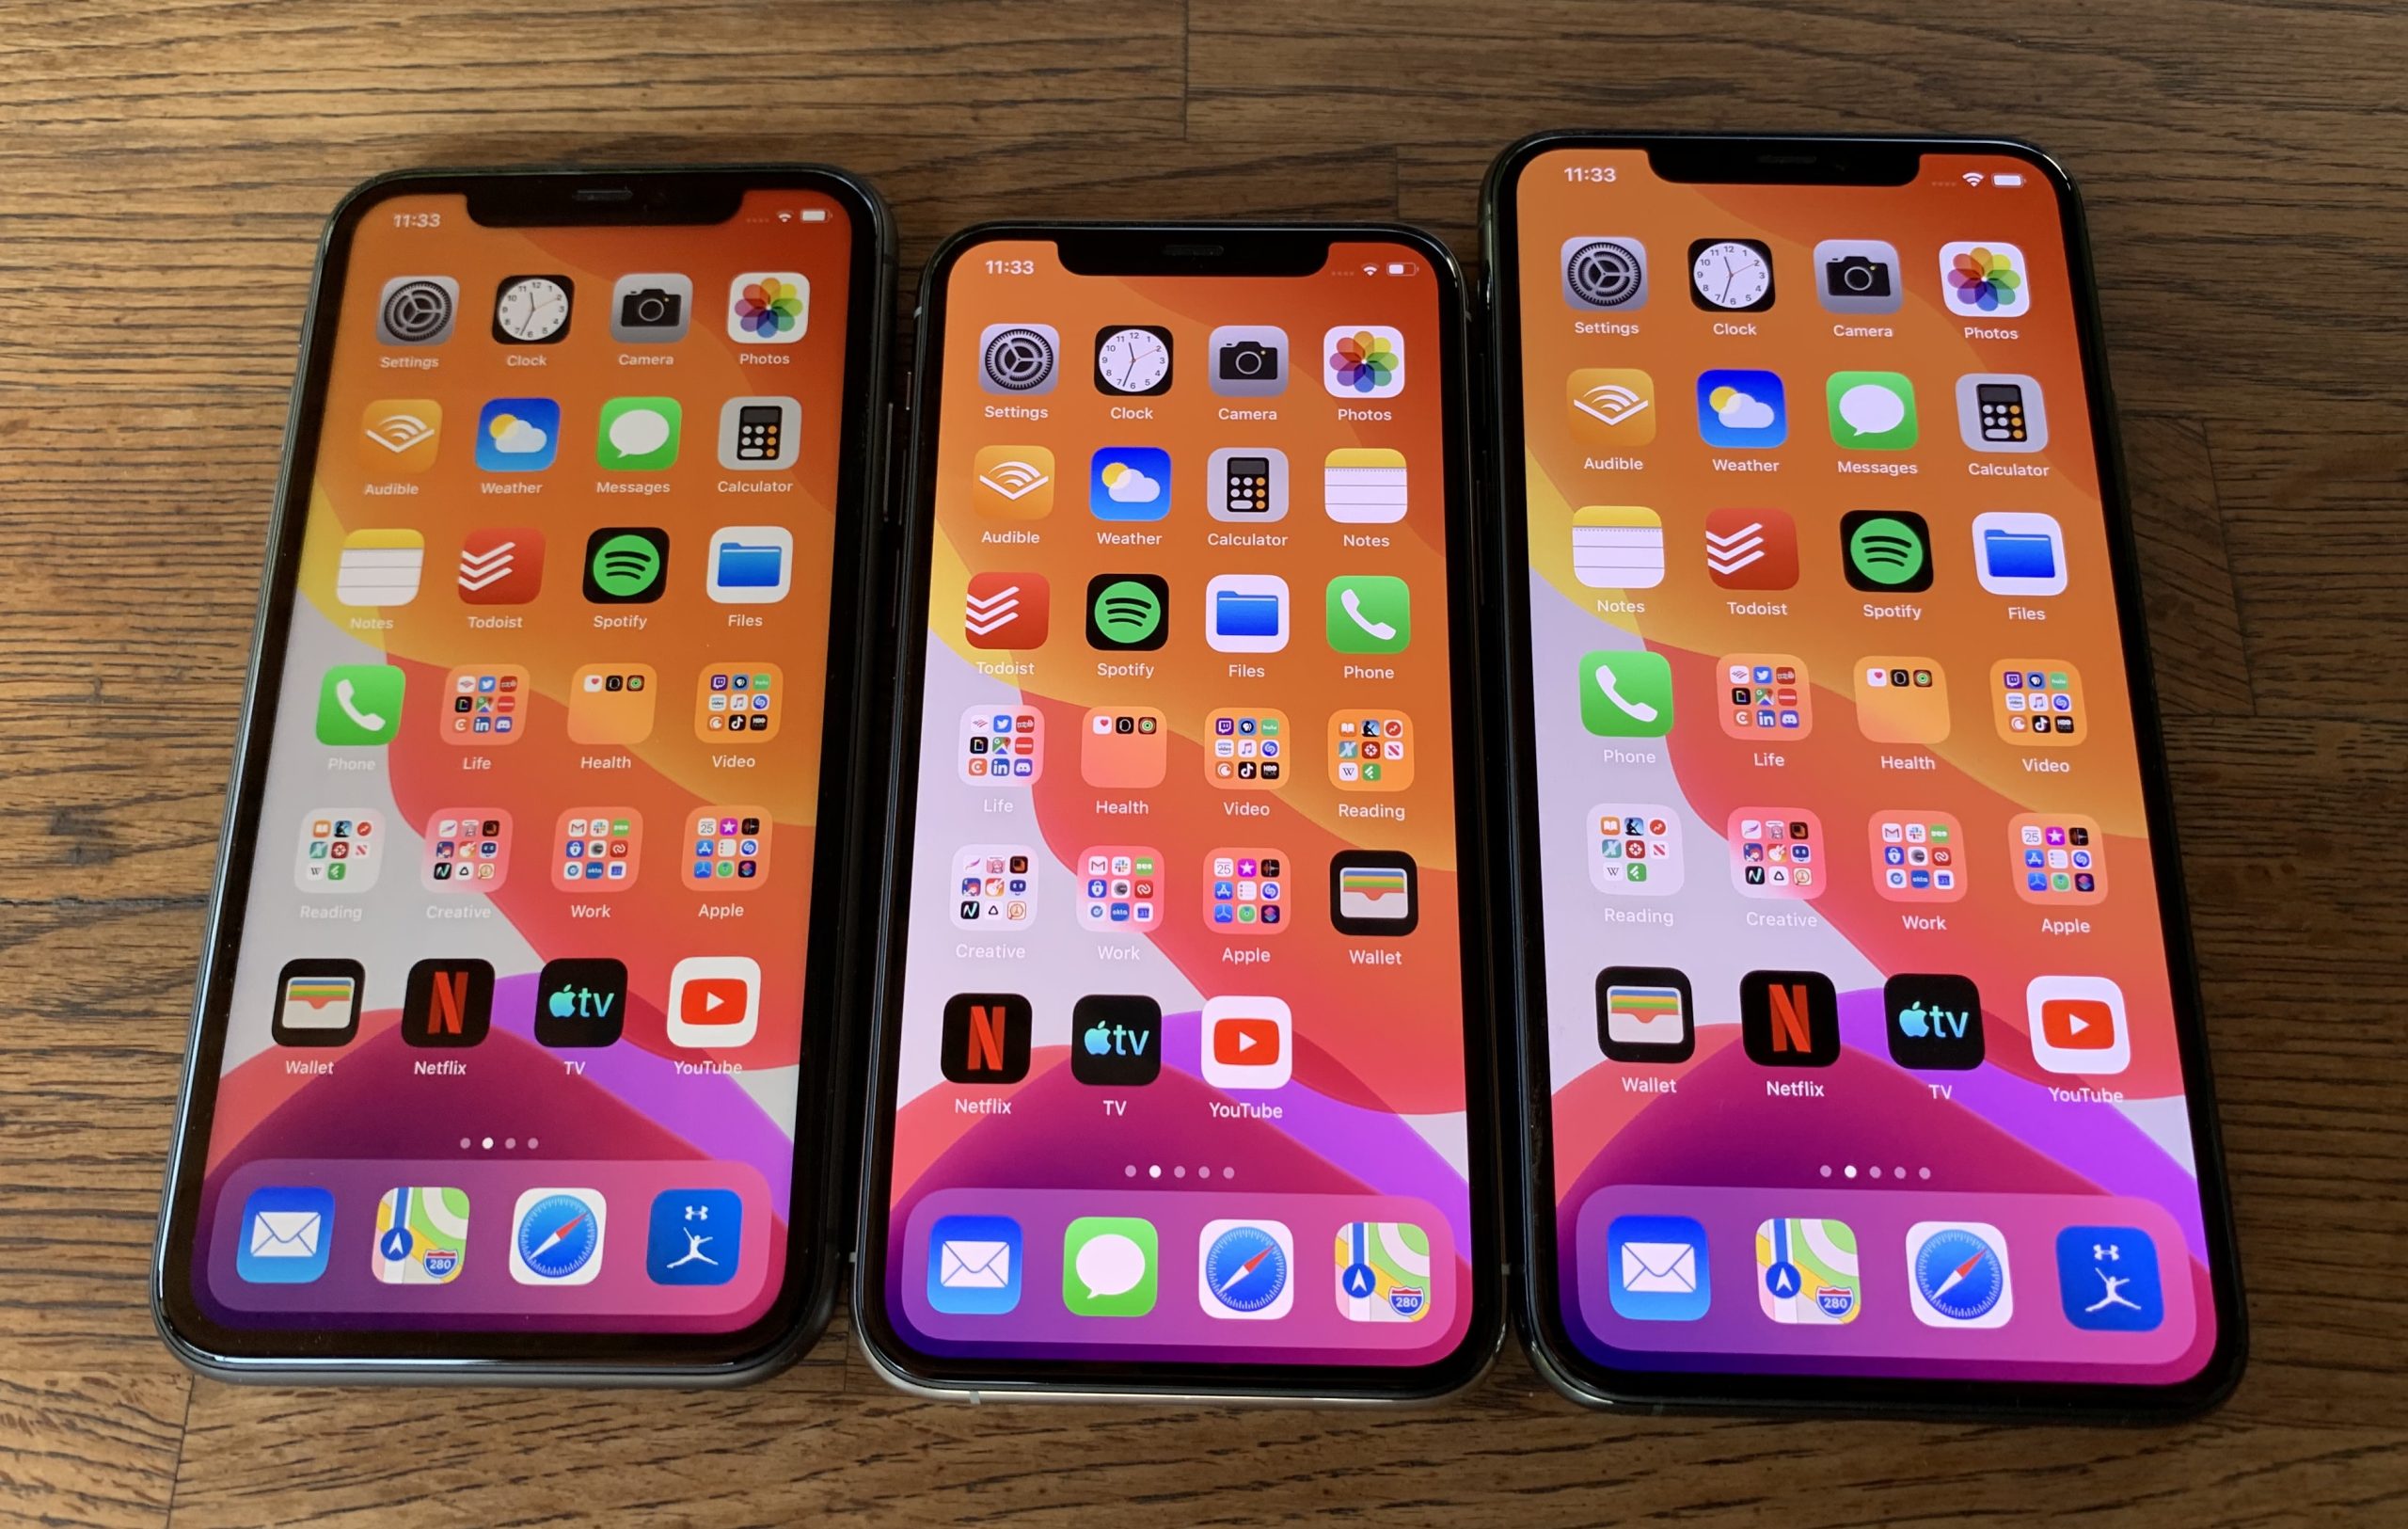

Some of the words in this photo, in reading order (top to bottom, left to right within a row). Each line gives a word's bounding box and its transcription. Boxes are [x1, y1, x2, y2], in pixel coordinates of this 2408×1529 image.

[1563, 167, 1617, 183] 11:33
[393, 213, 441, 228] 11:33
[985, 260, 1035, 275] 11:33
[1575, 321, 1640, 337] Settings
[1712, 323, 1757, 336] Clock
[1832, 324, 1894, 338] Camera
[1963, 327, 2020, 340] Photos
[379, 356, 439, 371] Settings
[505, 354, 547, 367] Clock
[617, 353, 674, 366] Camera
[739, 353, 790, 365] Photos
[984, 405, 1049, 422] Settings
[1110, 406, 1153, 420] Clock
[1218, 407, 1277, 421] Camera
[1338, 408, 1392, 422] Photos
[1583, 456, 1644, 470] Audible
[1712, 458, 1780, 472] Weather
[1837, 460, 1919, 477] Messages
[1968, 462, 2051, 477] Calculator
[364, 483, 420, 496] Audible
[481, 482, 543, 494] Weather
[595, 481, 671, 496] Messages
[717, 480, 794, 493] Calculator
[981, 531, 1040, 544] Audible
[1097, 532, 1163, 546] Weather
[1207, 533, 1289, 547] Calculator
[1343, 534, 1390, 548] Notes
[1596, 599, 1646, 613] Notes
[1726, 601, 1788, 616] Todoist
[1862, 603, 1922, 621] Spotify
[2007, 606, 2047, 621] Files
[349, 617, 394, 629] Notes
[467, 615, 523, 629] Todoist
[593, 614, 648, 630] Spotify
[728, 613, 763, 627] Files
[977, 661, 1036, 676] Todoist
[1097, 662, 1155, 679] Spotify
[1228, 663, 1265, 678] Files
[1343, 665, 1395, 679] Phone
[1758, 712, 1774, 725] in
[327, 757, 376, 771] Phone
[462, 757, 492, 771] Life
[580, 756, 632, 770] Health
[712, 755, 756, 769] Video
[1603, 749, 1656, 764] Phone
[1753, 752, 1785, 767] Life
[1880, 756, 1936, 770] Health
[993, 760, 1008, 774] in
[1342, 768, 1354, 776] W
[2021, 757, 2070, 773] Video
[984, 798, 1014, 813] Life
[1096, 800, 1149, 815] Health
[1223, 801, 1271, 817] Video
[1339, 803, 1405, 821] Reading
[700, 823, 714, 834] 25
[2025, 833, 2039, 842] 25
[1217, 865, 1231, 874] 25
[1608, 868, 1619, 876] W
[300, 904, 363, 922] Reading
[425, 904, 492, 919] Creative
[571, 903, 611, 918] Work
[698, 902, 745, 920] Apple
[1604, 907, 1674, 927] Reading
[1746, 911, 1818, 928] Creative
[1901, 915, 1947, 931] Work
[2041, 917, 2091, 936] Apple
[956, 943, 1026, 959] Creative
[1097, 945, 1140, 961] Work
[1222, 947, 1271, 965] Apple
[1348, 949, 1402, 965] Wallet
[578, 987, 614, 1018] tv
[1929, 1006, 1969, 1039] tv
[1114, 1026, 1149, 1056] tv
[285, 1059, 335, 1075] Wallet
[414, 1059, 467, 1075] Netflix
[563, 1060, 586, 1075] TV
[673, 1059, 743, 1076] YouTube
[1621, 1076, 1677, 1093] Wallet
[1766, 1080, 1825, 1097] Netflix
[1927, 1083, 1953, 1100] TV
[2047, 1087, 2124, 1105] YouTube
[955, 1098, 1012, 1115] Netflix
[1102, 1099, 1127, 1116] TV
[1209, 1101, 1283, 1119] YouTube
[430, 1258, 451, 1270] 280
[1395, 1296, 1418, 1309] 280
[1824, 1296, 1848, 1310] 280
